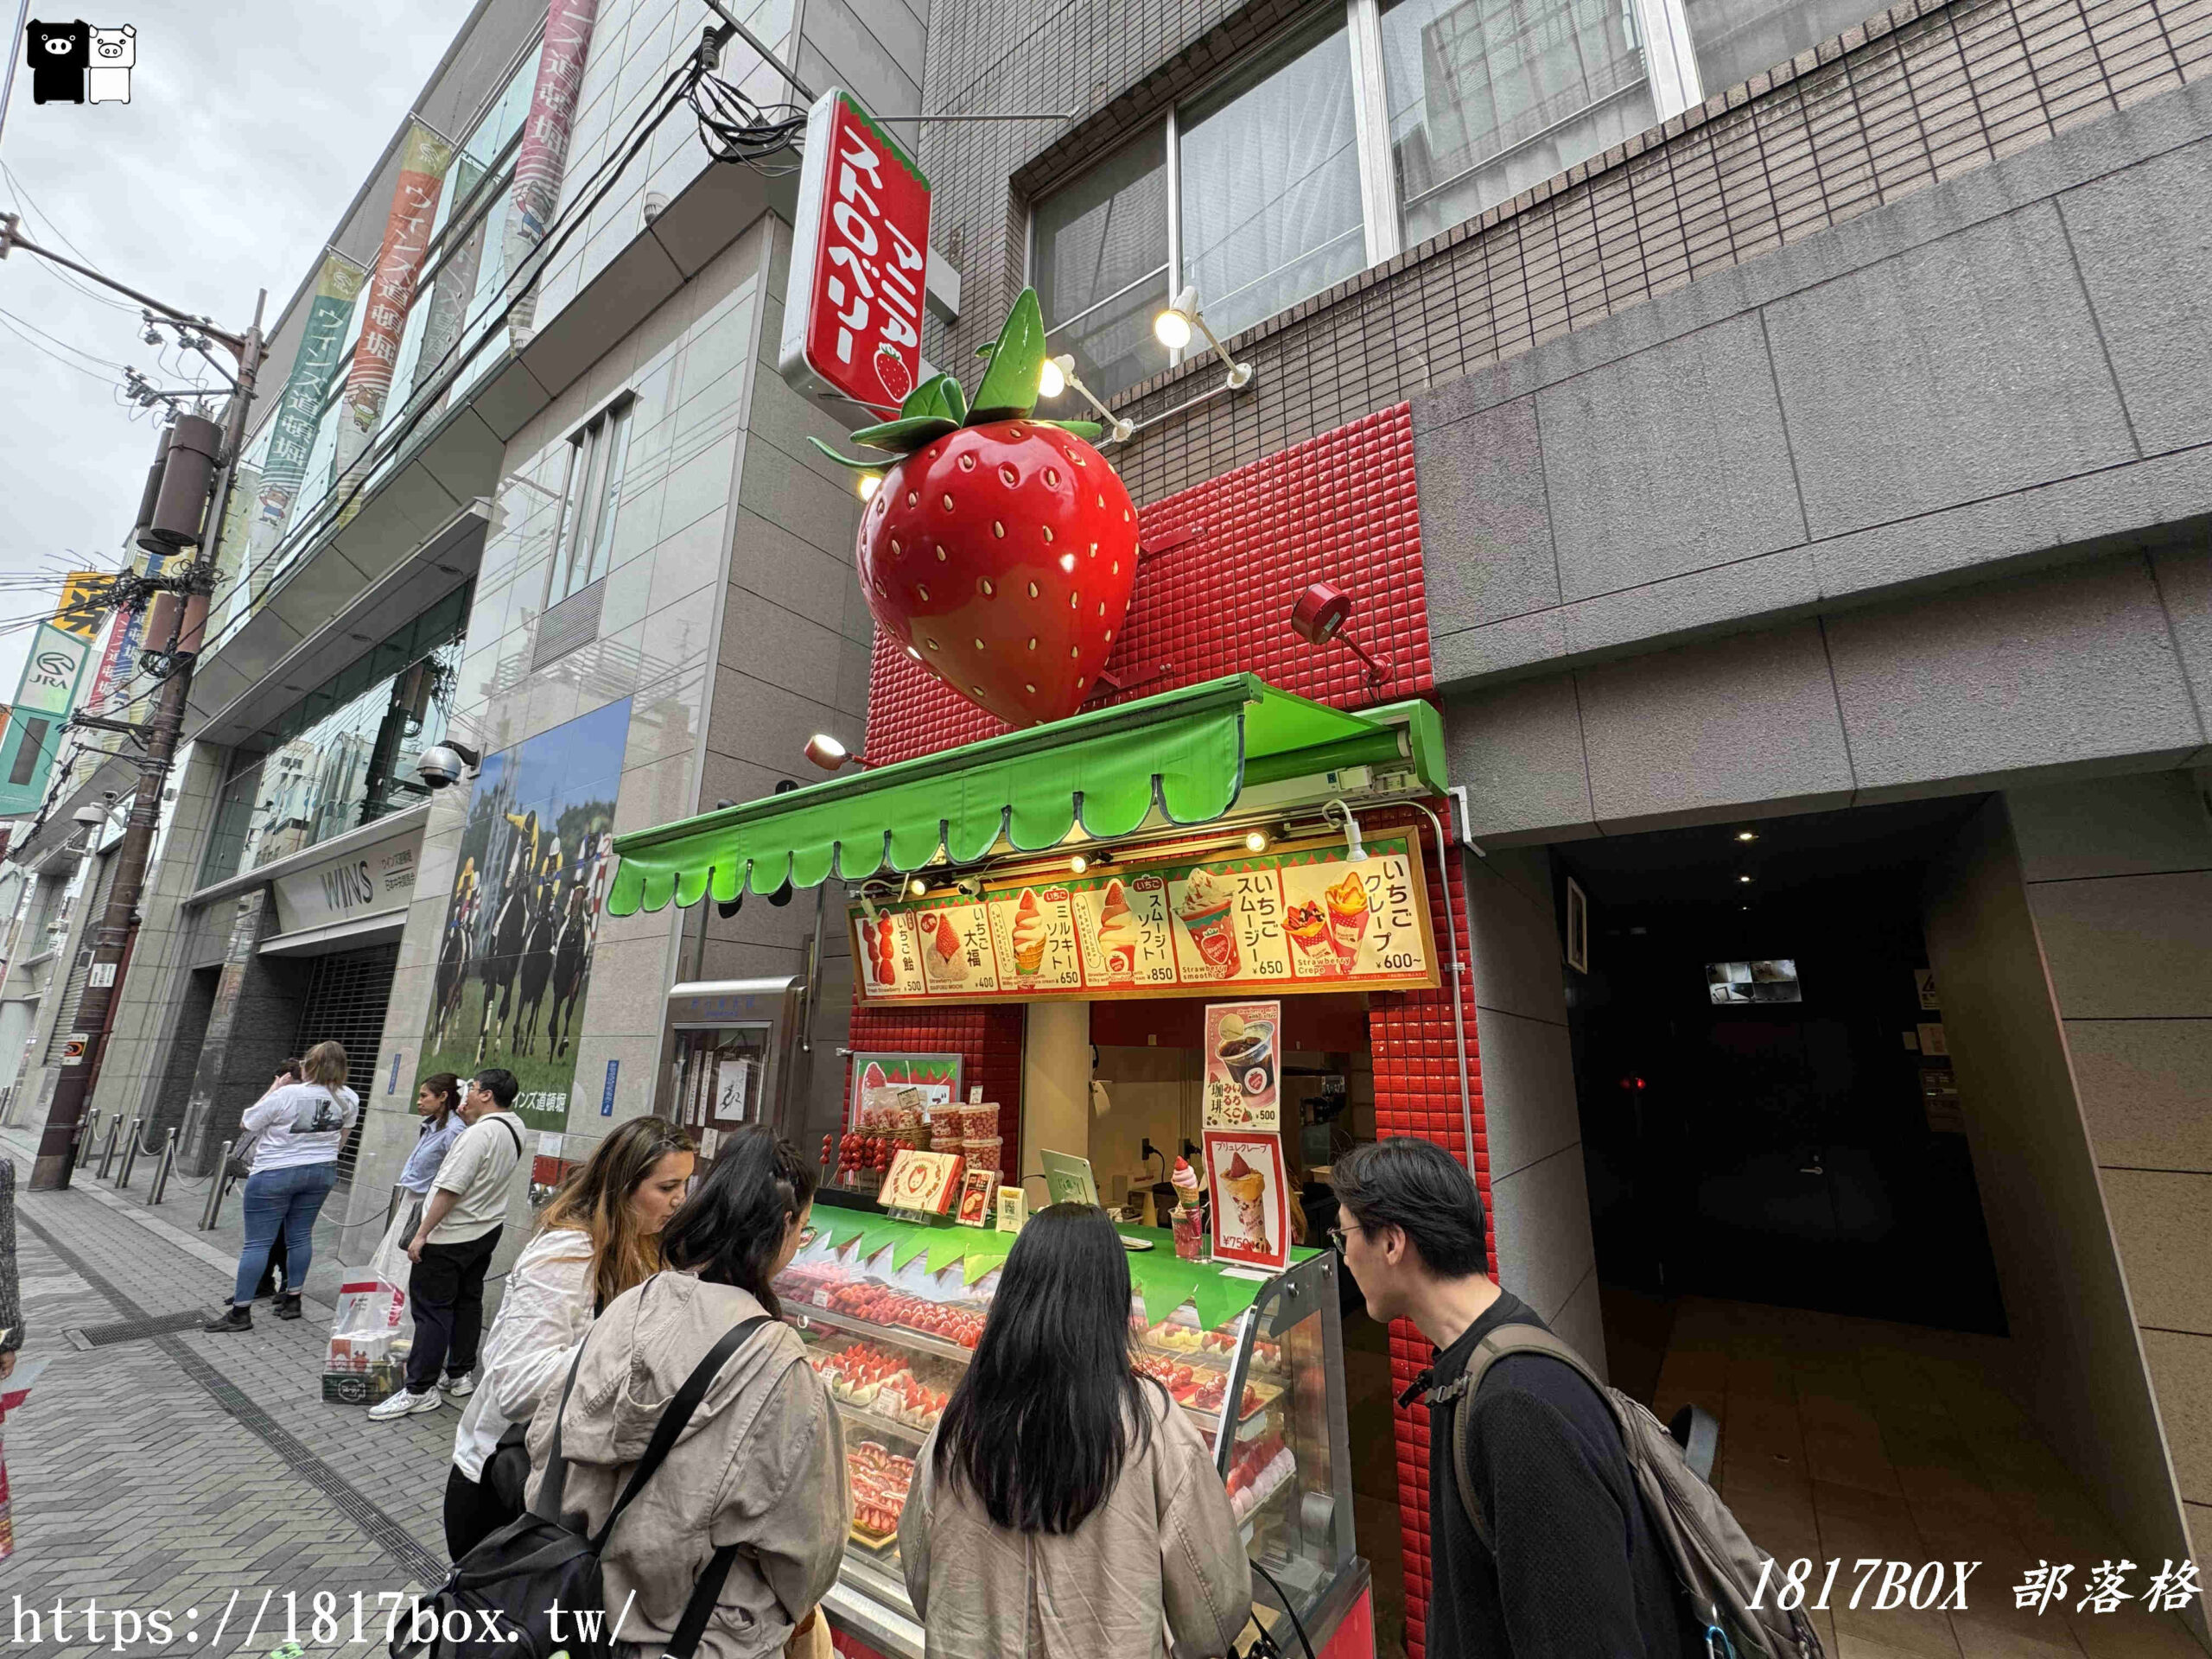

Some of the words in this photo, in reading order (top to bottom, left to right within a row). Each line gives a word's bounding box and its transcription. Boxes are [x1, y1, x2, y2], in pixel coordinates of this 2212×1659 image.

[827, 124, 883, 365] ストロベリー
[365, 184, 434, 366] ウインズ道頓堀
[879, 219, 924, 348] マニア
[272, 307, 344, 467] ウインズ道頓堀
[29, 674, 68, 690] JRA
[319, 860, 374, 912] WINS
[1255, 875, 1279, 938] いちご
[1382, 860, 1412, 928] いちご
[973, 906, 989, 950] いちご
[1149, 894, 1166, 960] スムージー
[1236, 877, 1260, 963] スムージー
[1364, 874, 1392, 952] クレープ
[897, 917, 915, 972] いちご飴
[963, 929, 982, 968] 大福
[1046, 923, 1063, 970] ソフト
[1056, 905, 1074, 969] ミルキー
[1138, 914, 1154, 961] ソフト
[975, 976, 995, 988] ¥400
[1055, 971, 1078, 984] ¥650
[1147, 967, 1173, 981] ¥850
[1182, 964, 1228, 973] Strawberry
[1183, 971, 1225, 980] smoothies
[1252, 960, 1283, 976] ¥650
[1298, 956, 1351, 967] Strawberry
[1299, 966, 1325, 975] Crepe
[512, 1090, 568, 1114] インズ道頓堀
[1211, 1083, 1224, 1115] 珈琲
[1223, 1083, 1233, 1118] みるく
[1232, 1083, 1243, 1118] いちご
